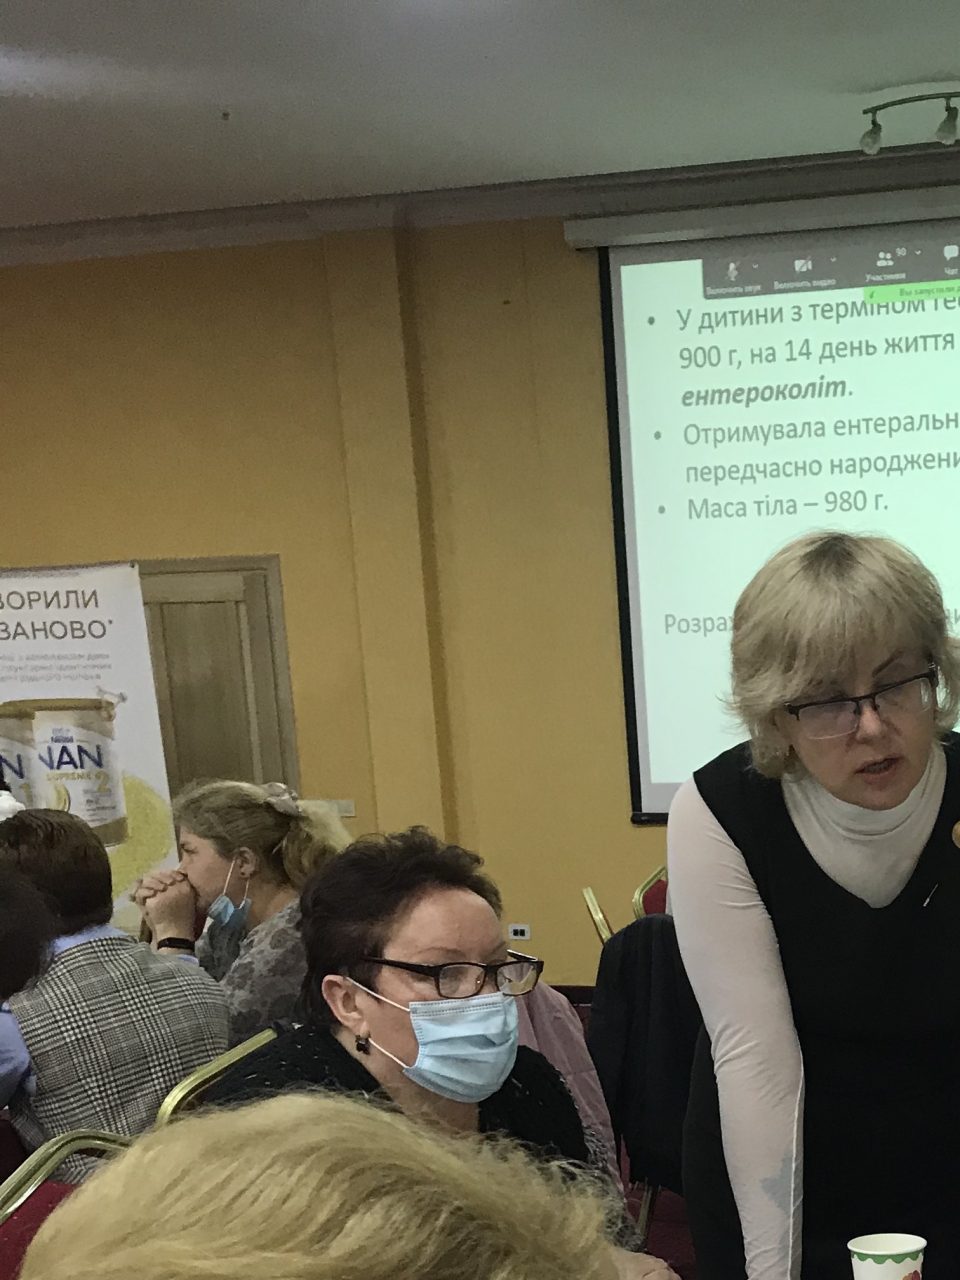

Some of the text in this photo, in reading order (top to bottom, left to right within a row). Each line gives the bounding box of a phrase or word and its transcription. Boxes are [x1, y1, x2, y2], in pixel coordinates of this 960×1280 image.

[676, 309, 692, 331] У
[697, 307, 785, 334] дитини
[790, 305, 803, 322] з
[808, 297, 926, 323] терміном
[679, 345, 722, 370] 900
[729, 349, 742, 370] г,
[750, 345, 777, 364] на
[785, 339, 812, 362] 14
[819, 336, 877, 365] день
[884, 331, 956, 355] життя
[681, 375, 854, 408] ентероколіт.
[683, 420, 827, 446] Отримувала
[685, 456, 823, 485] передчасно
[687, 488, 889, 520] Маса тіла 980 г.
[664, 613, 733, 638] Розра
